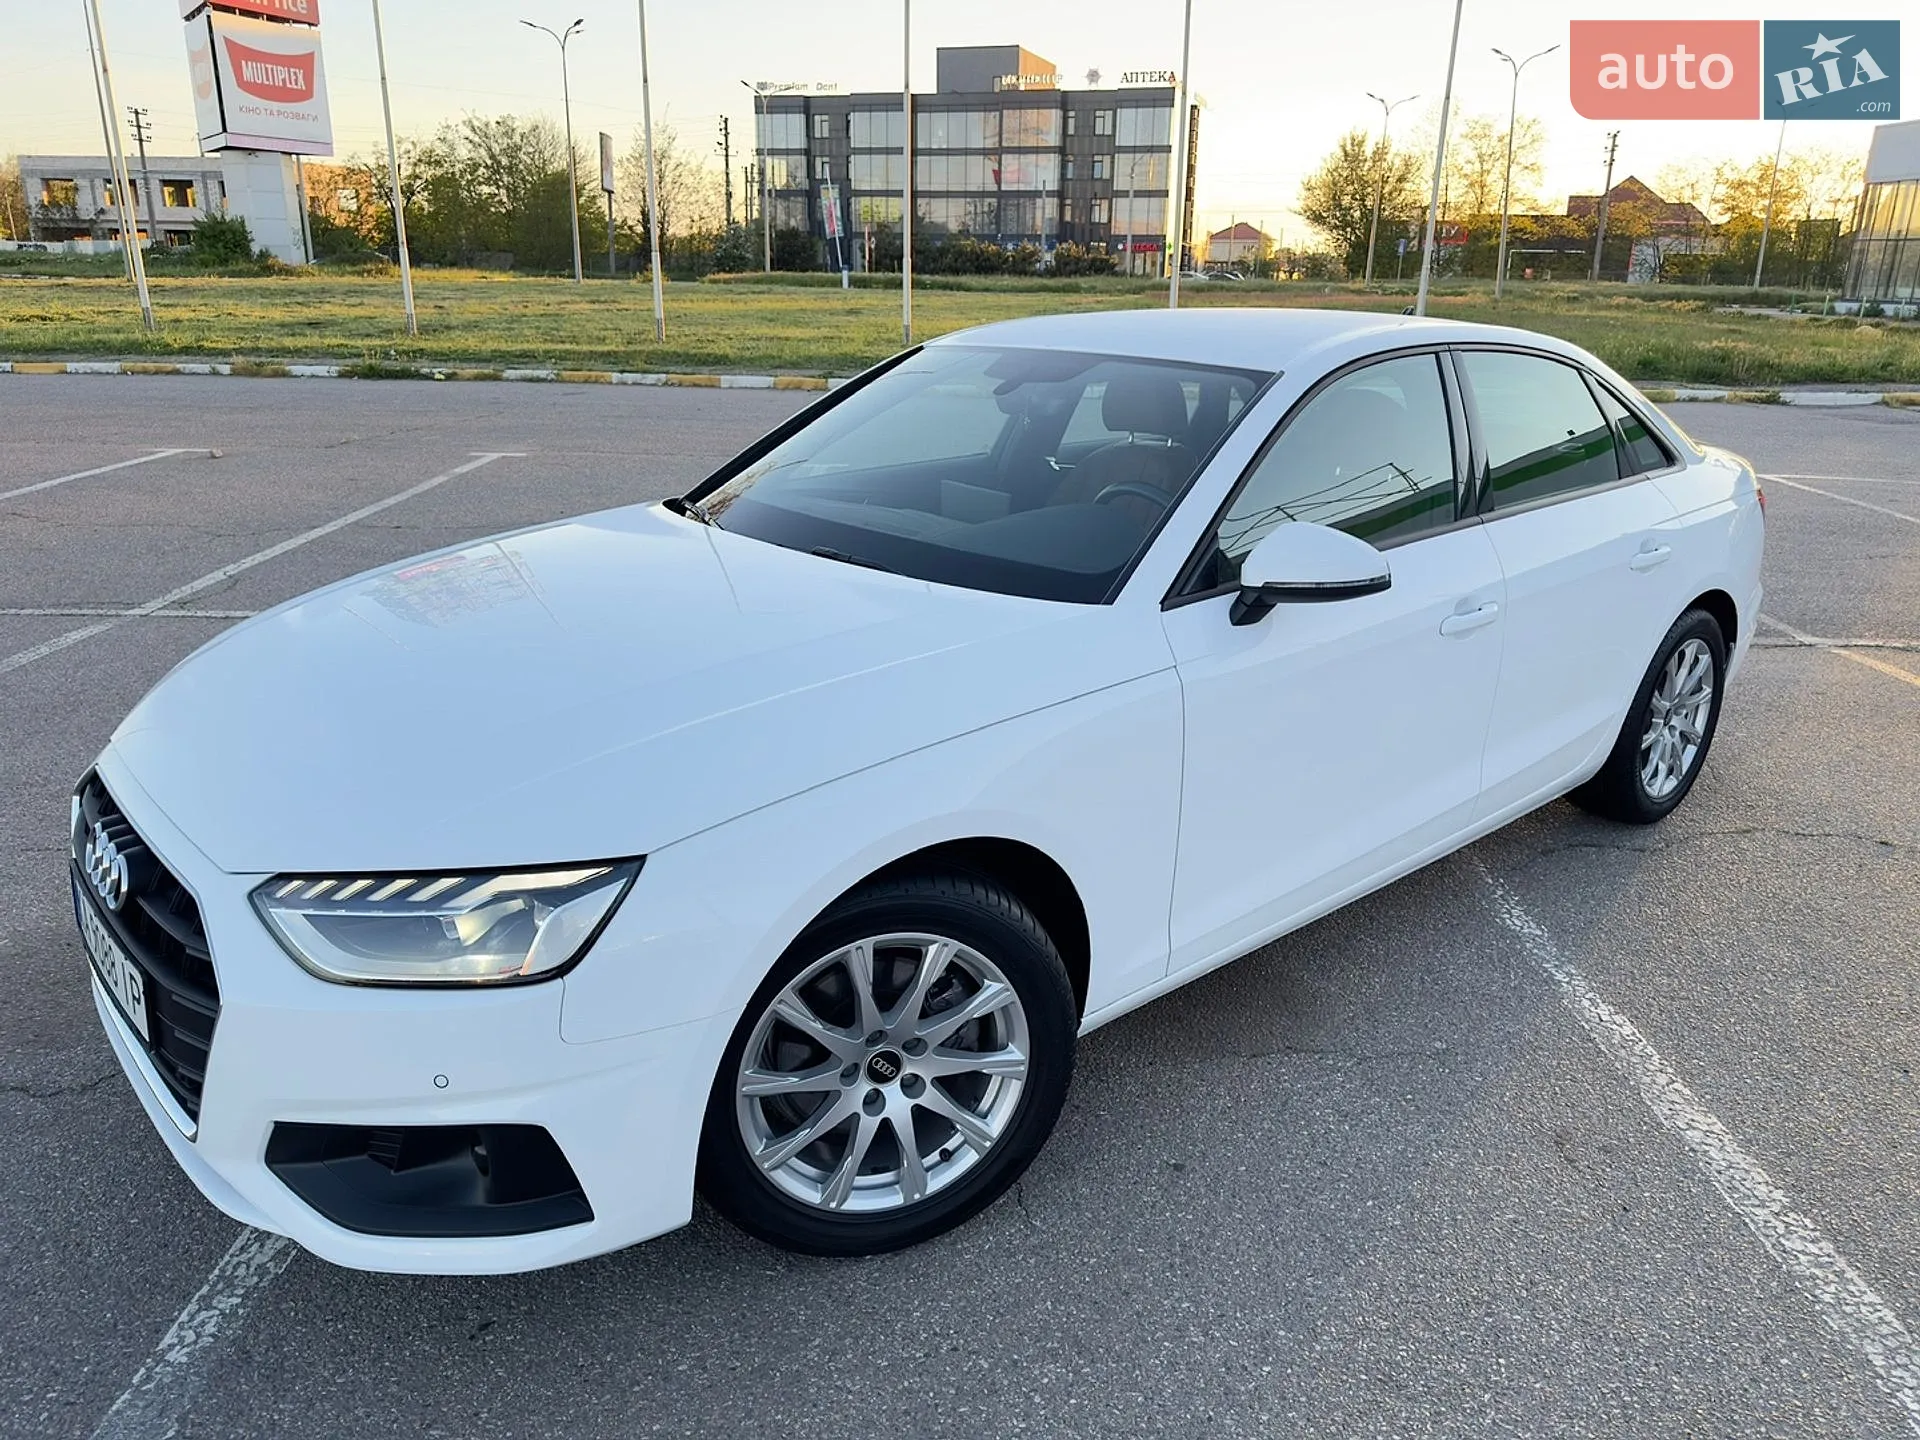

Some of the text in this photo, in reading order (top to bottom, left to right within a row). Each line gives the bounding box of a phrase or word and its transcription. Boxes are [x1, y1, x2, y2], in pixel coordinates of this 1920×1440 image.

[241, 59, 306, 91] MULTIPLEX
[1120, 71, 1176, 84] АПТЕКА
[239, 104, 319, 123] КІНО ТА РОЗВАГИ
